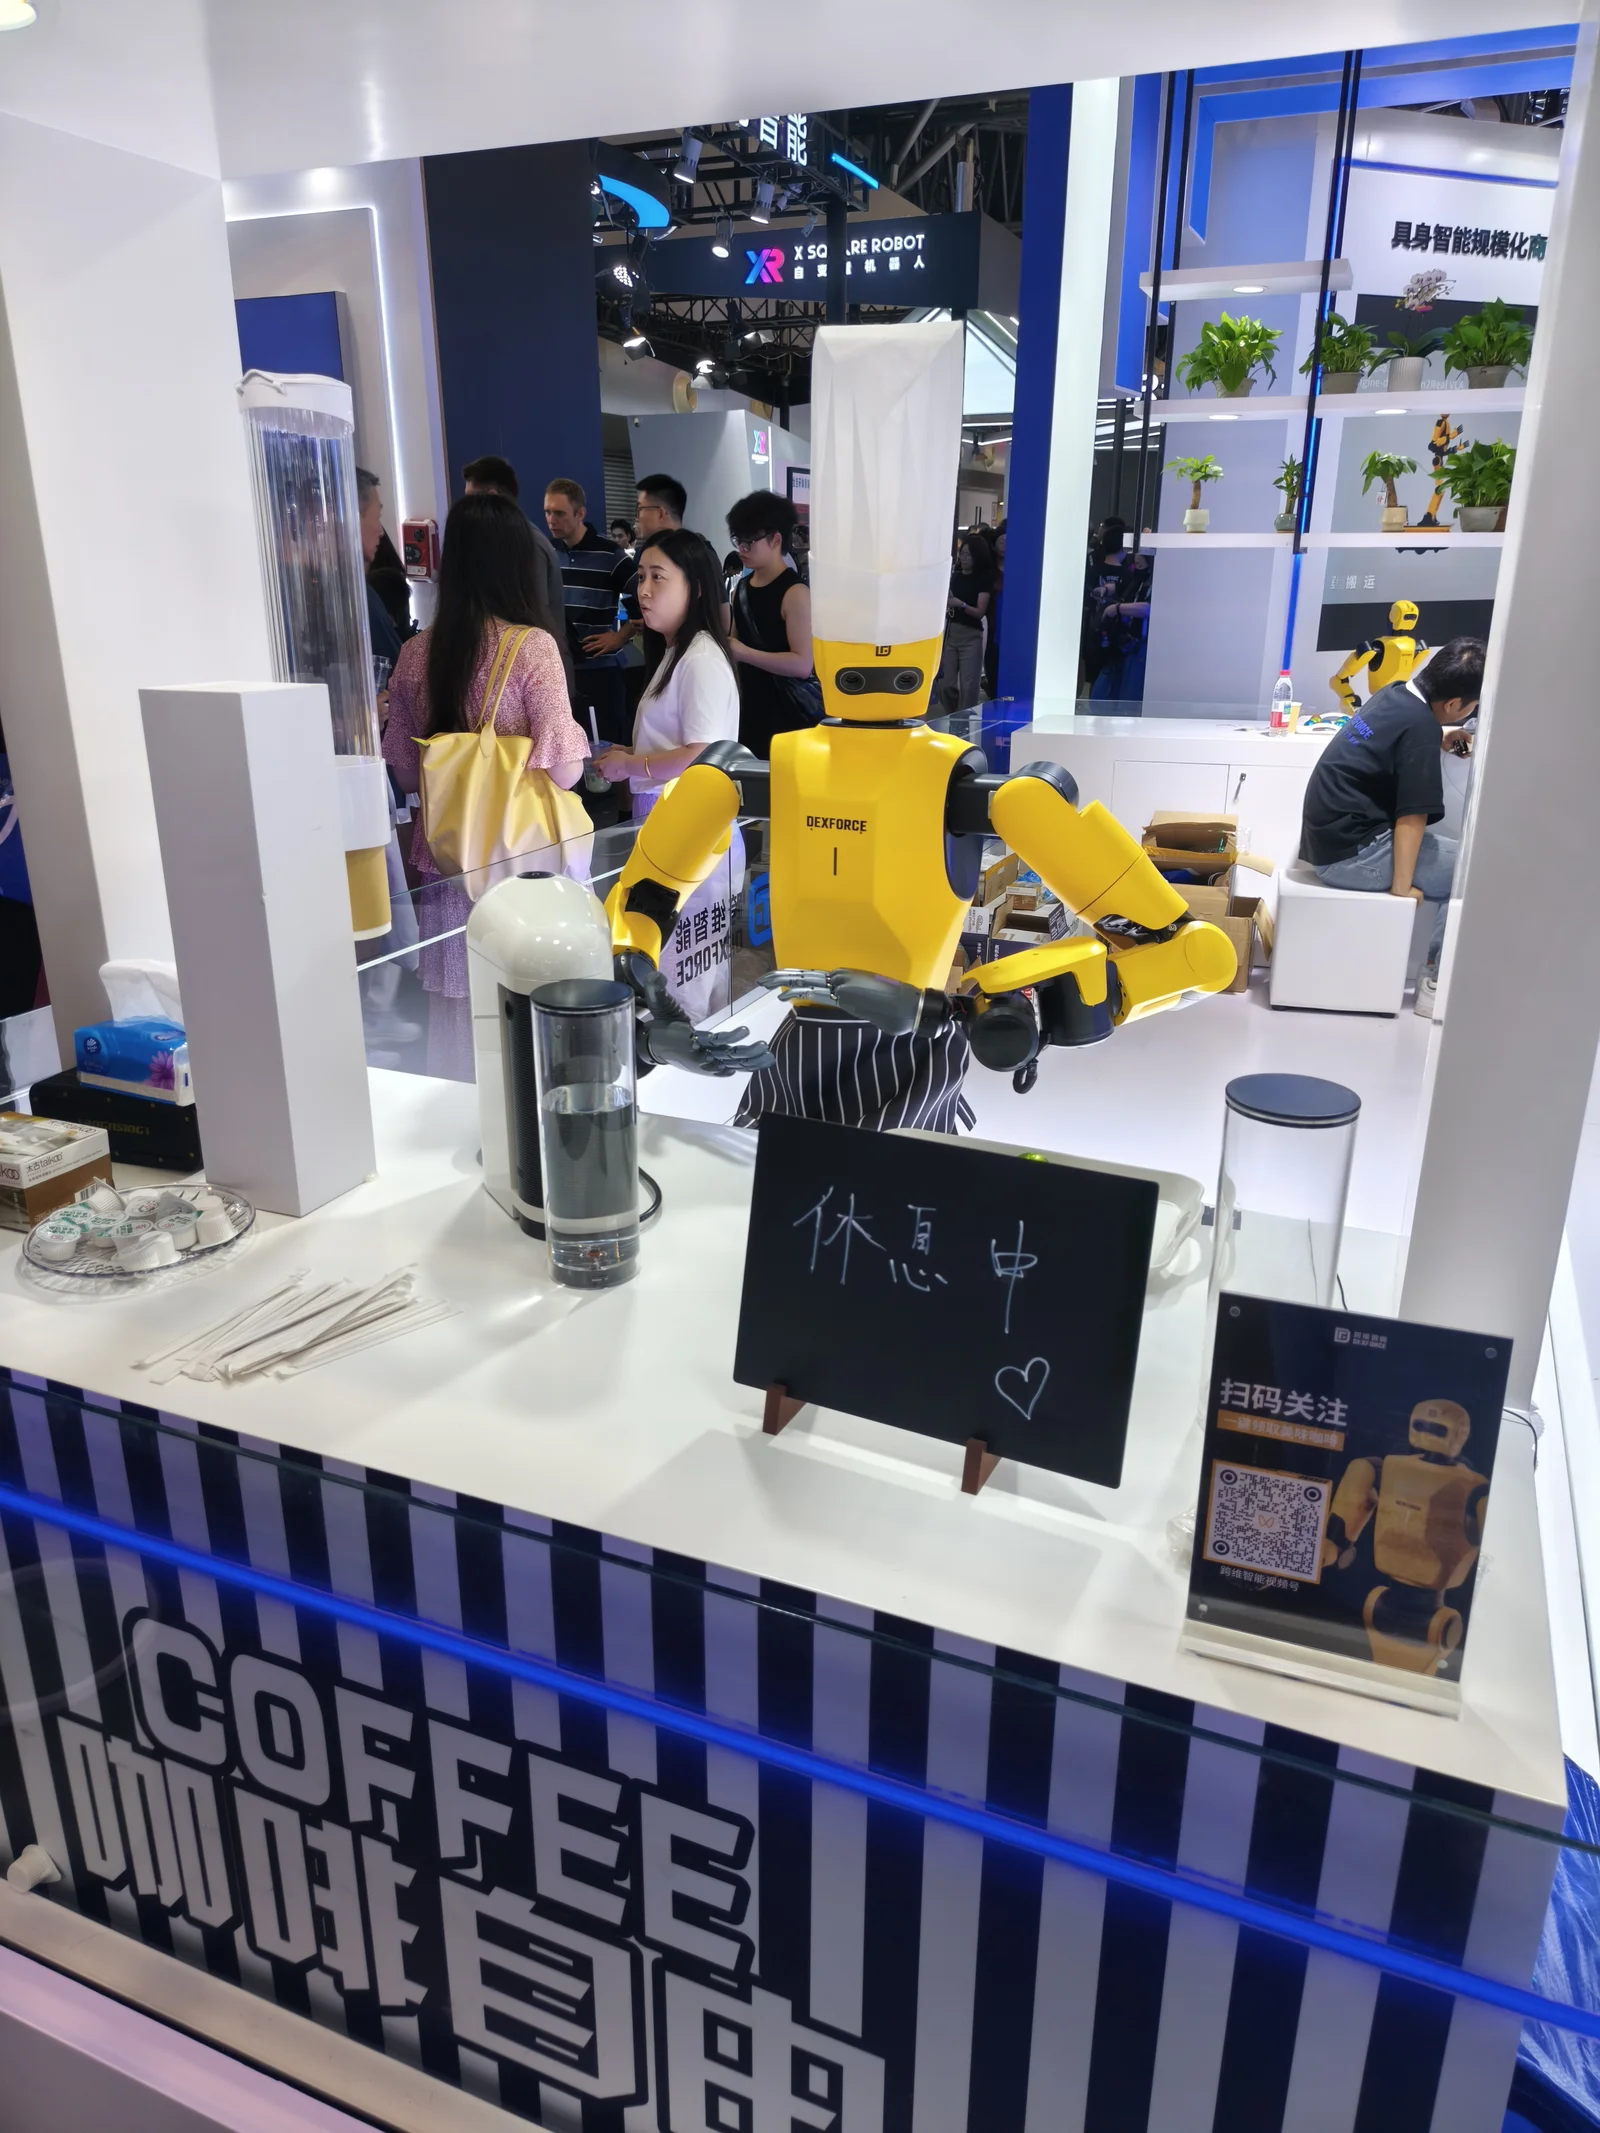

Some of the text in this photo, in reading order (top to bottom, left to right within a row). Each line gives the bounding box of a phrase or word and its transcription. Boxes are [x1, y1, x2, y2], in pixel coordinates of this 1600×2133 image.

[794, 234, 926, 261] X SQRE ROBOT
[1391, 220, 1548, 262] 具身智能规模化商
[806, 815, 867, 832] DEXFORCE
[793, 1186, 1038, 1334] 休息中
[1220, 1378, 1349, 1427] 扫码关注
[1219, 1565, 1300, 1592] 跨维智能视频号
[131, 1617, 745, 1972] COFFEE
